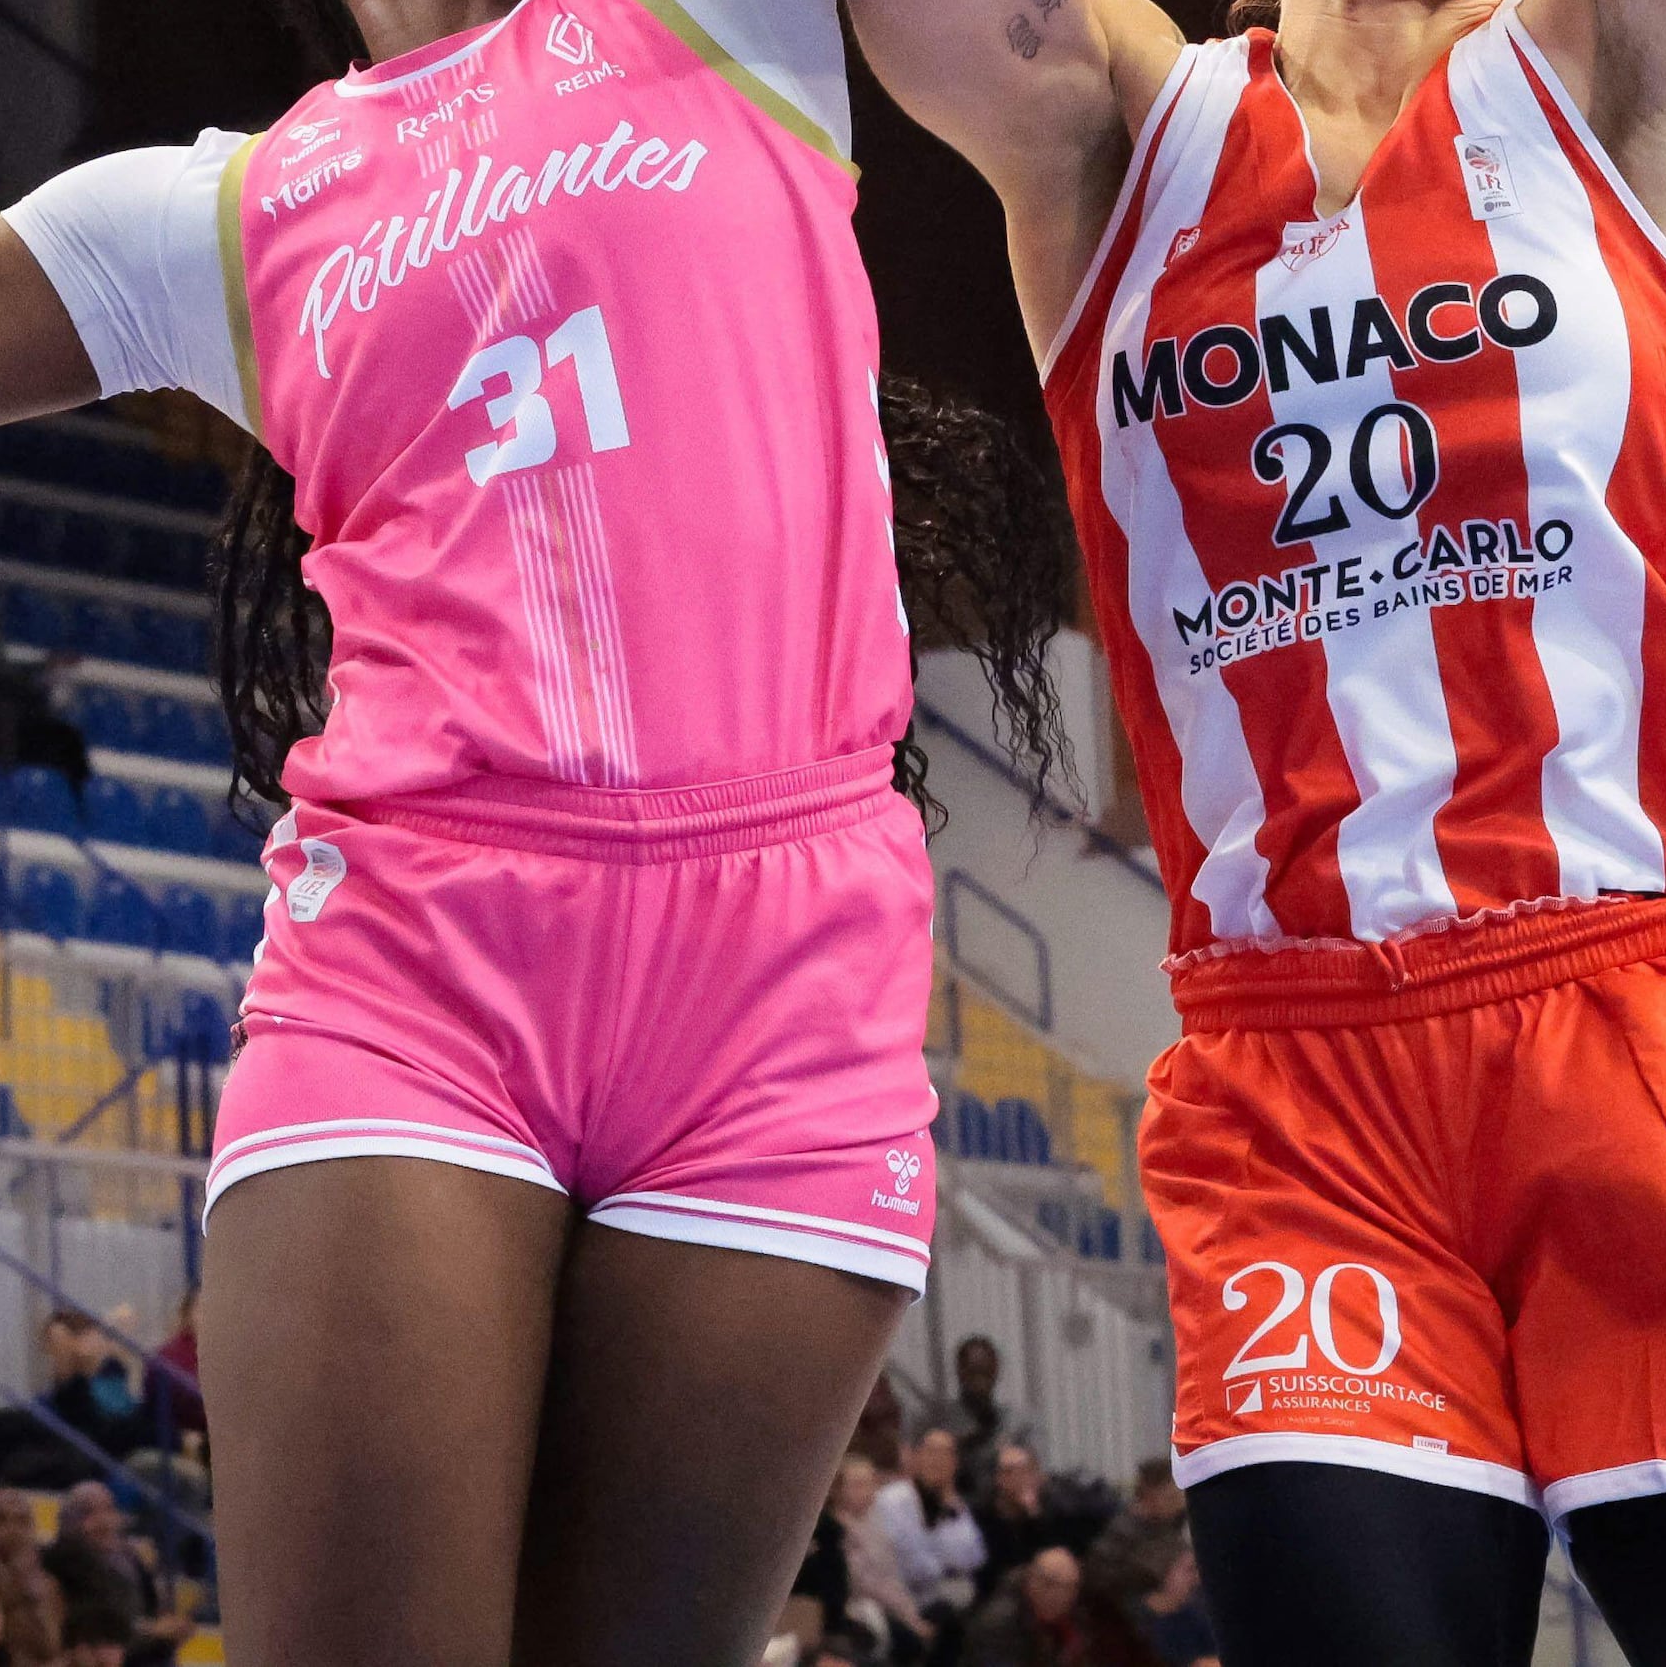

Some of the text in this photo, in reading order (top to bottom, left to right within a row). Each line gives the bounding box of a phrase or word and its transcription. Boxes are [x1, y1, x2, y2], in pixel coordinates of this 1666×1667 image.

[554, 60, 627, 97] REIMS
[396, 83, 496, 145] Reims
[280, 130, 341, 170] hummel
[261, 152, 364, 222] Marne
[299, 120, 708, 380] Pétillantes
[1113, 273, 1558, 429] MONACO
[447, 305, 632, 488] 31
[1251, 401, 1439, 546] 20
[1189, 564, 1574, 676] SOCIÉTÉ DES BAINS DE MER
[871, 1189, 921, 1216] hummel
[1221, 1260, 1403, 1380] 20
[1268, 1375, 1446, 1412] SUISSCOURTAGE
[1271, 1397, 1371, 1414] ASSURANCES
